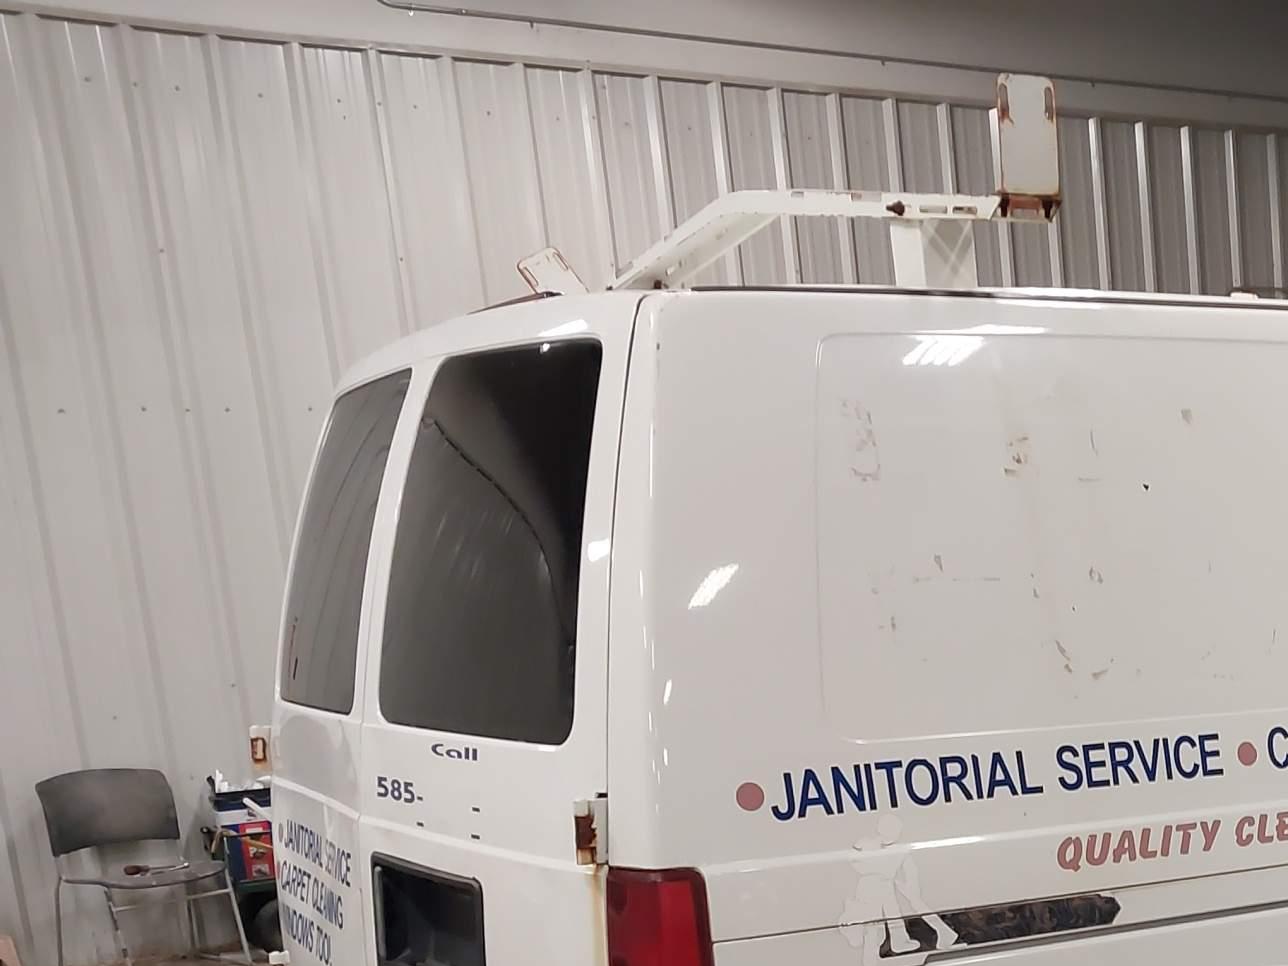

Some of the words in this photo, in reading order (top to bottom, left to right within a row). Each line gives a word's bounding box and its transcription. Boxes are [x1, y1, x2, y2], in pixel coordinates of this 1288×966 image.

[431, 743, 478, 761] Call
[376, 775, 424, 804] 585-
[771, 750, 1044, 821] JANITORIAL
[1056, 733, 1224, 791] SERVICE
[1056, 819, 1221, 872] QUALITY
[281, 860, 312, 904] CARPET
